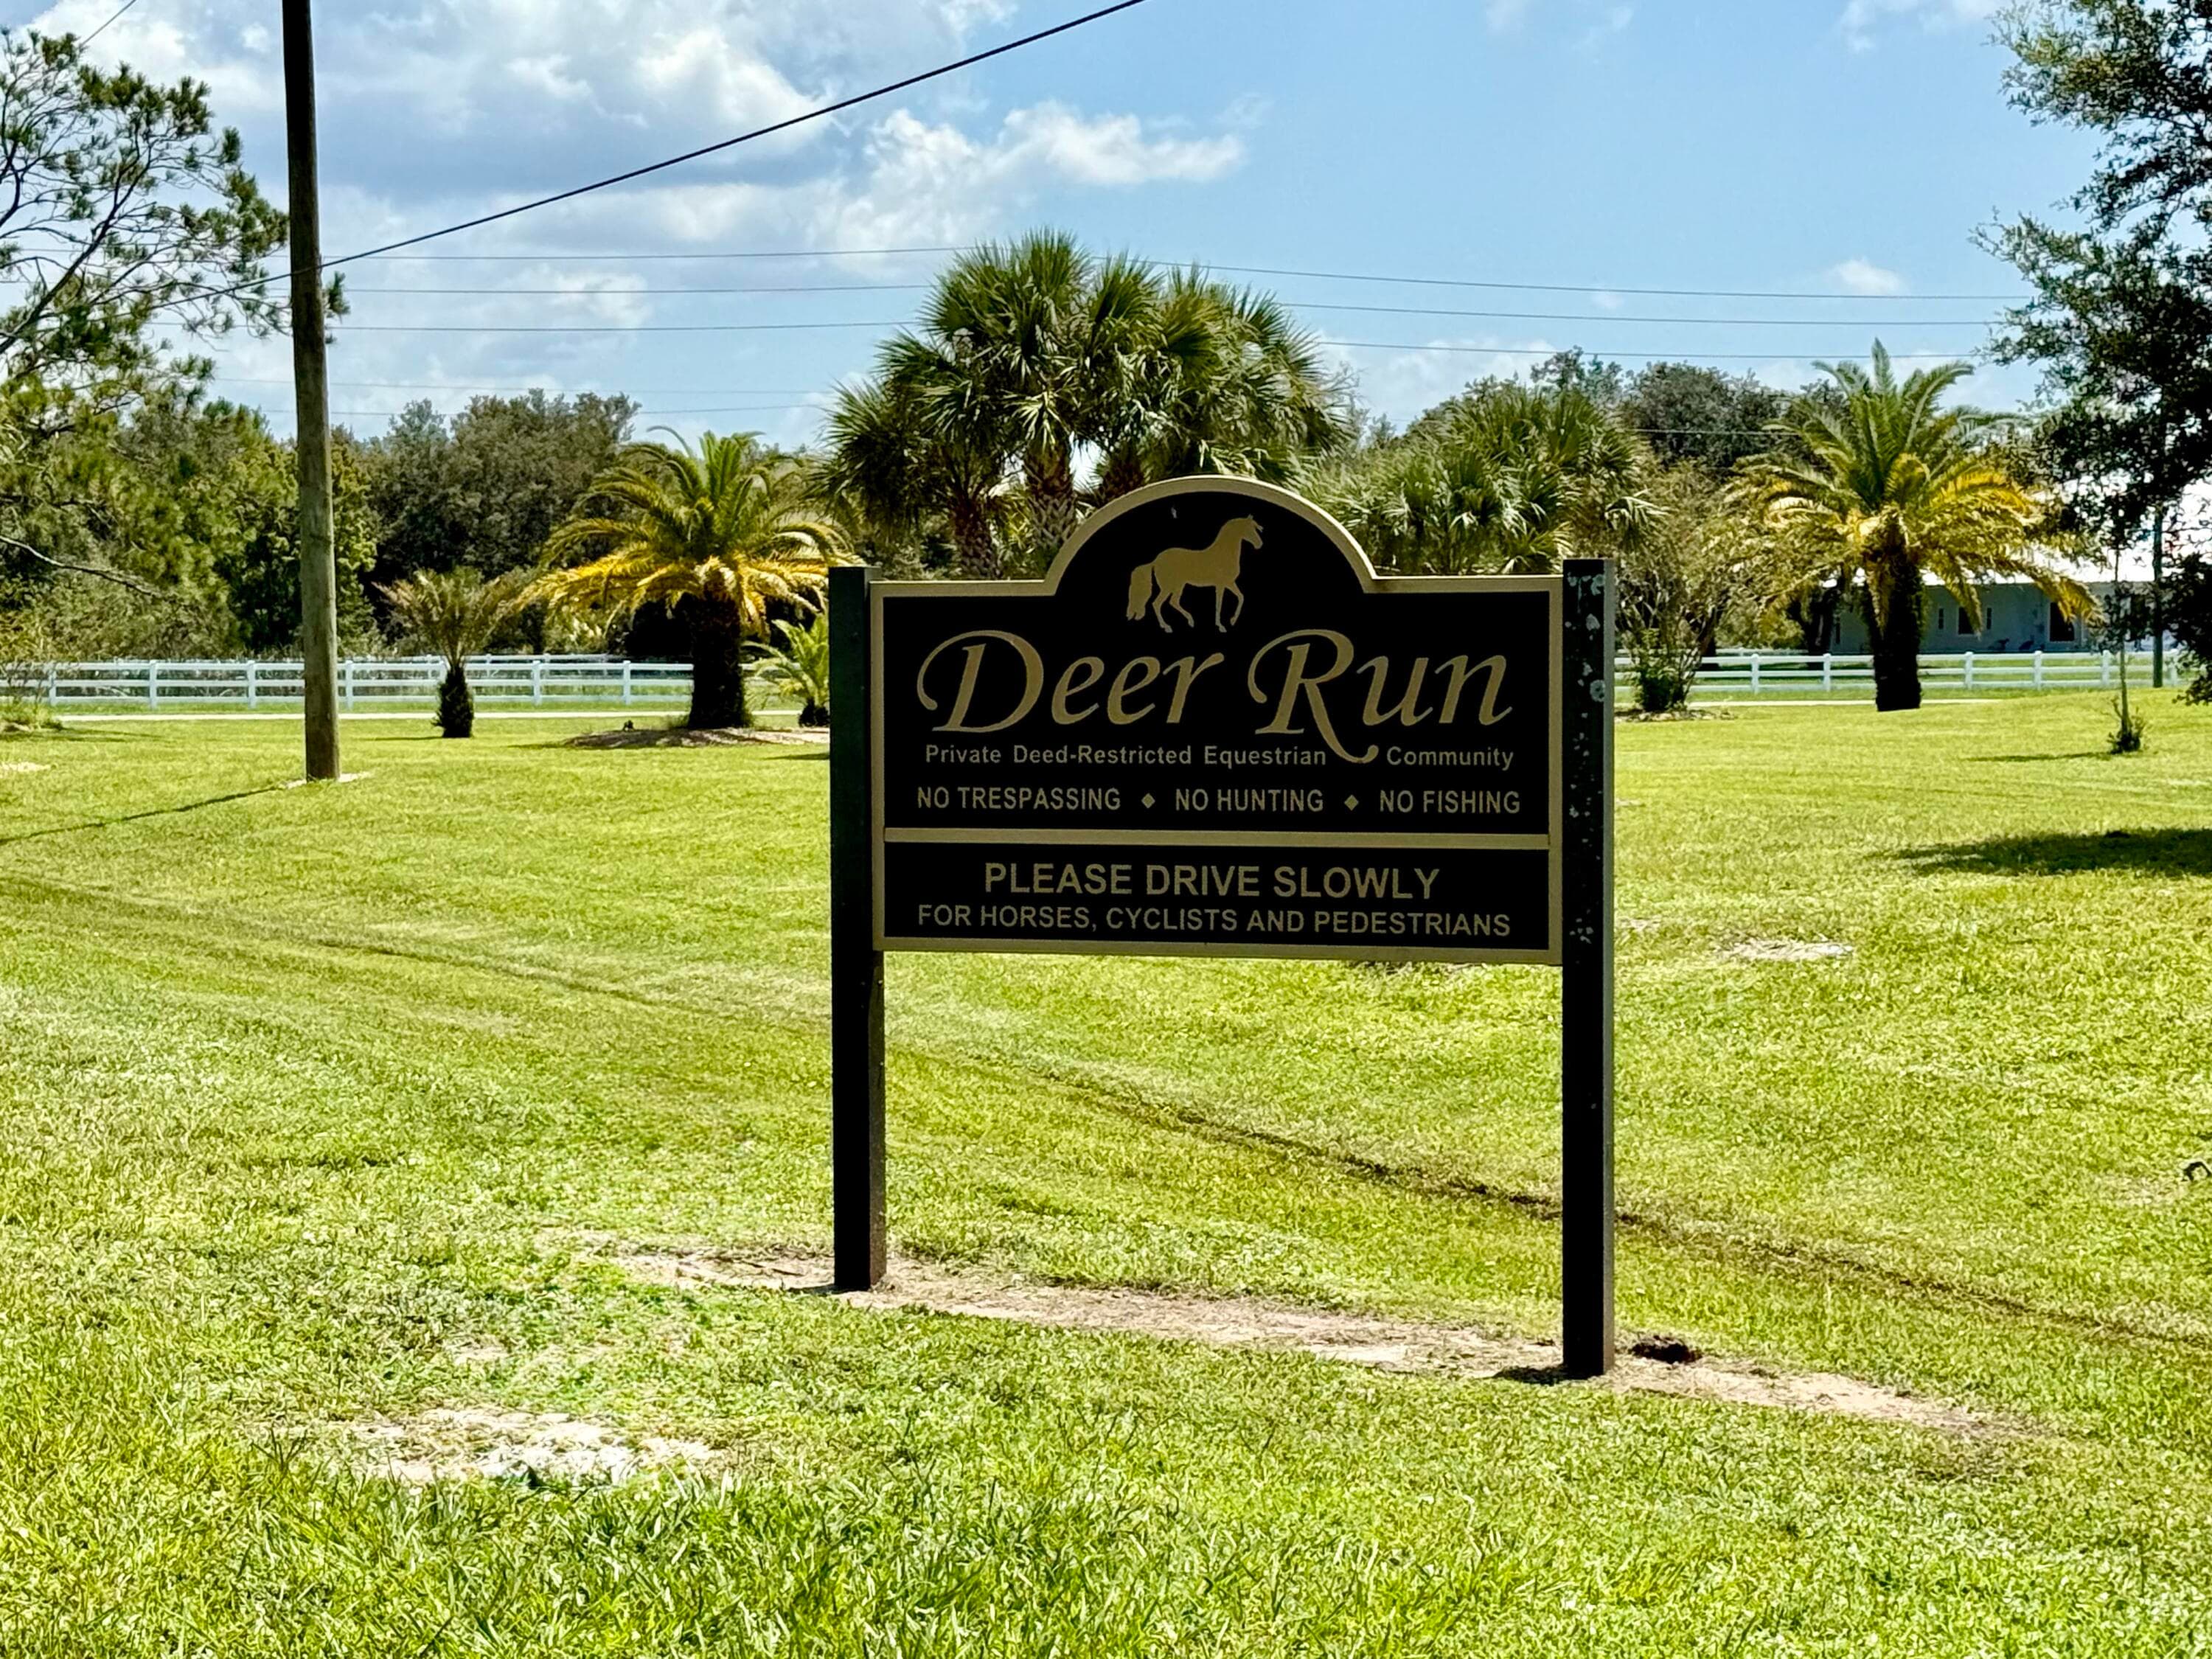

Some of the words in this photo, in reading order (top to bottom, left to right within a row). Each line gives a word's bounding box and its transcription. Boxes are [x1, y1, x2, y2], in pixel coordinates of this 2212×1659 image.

[917, 630, 1224, 733] Deer
[1247, 628, 1512, 764] Run
[926, 745, 1002, 763] Private
[1013, 745, 1192, 764] Deed-Restricted
[1203, 745, 1326, 769] Equestrian
[1386, 746, 1514, 771] Community
[917, 787, 950, 808] NO
[958, 787, 1121, 810] TRESPASSING
[1175, 789, 1209, 811] NO
[1217, 789, 1324, 812] HUNTING
[1380, 790, 1414, 813] NO
[1423, 790, 1520, 813] FISHING
[985, 863, 1133, 894] PLEASE
[1146, 864, 1260, 897] DRIVE
[1273, 866, 1440, 899] SLOWLY
[919, 904, 972, 926] FOR
[981, 905, 1097, 932] HORSES,
[1105, 907, 1238, 931] CYCLISTS
[1247, 910, 1304, 932] AND
[1315, 911, 1511, 936] PEDESTRIANS
